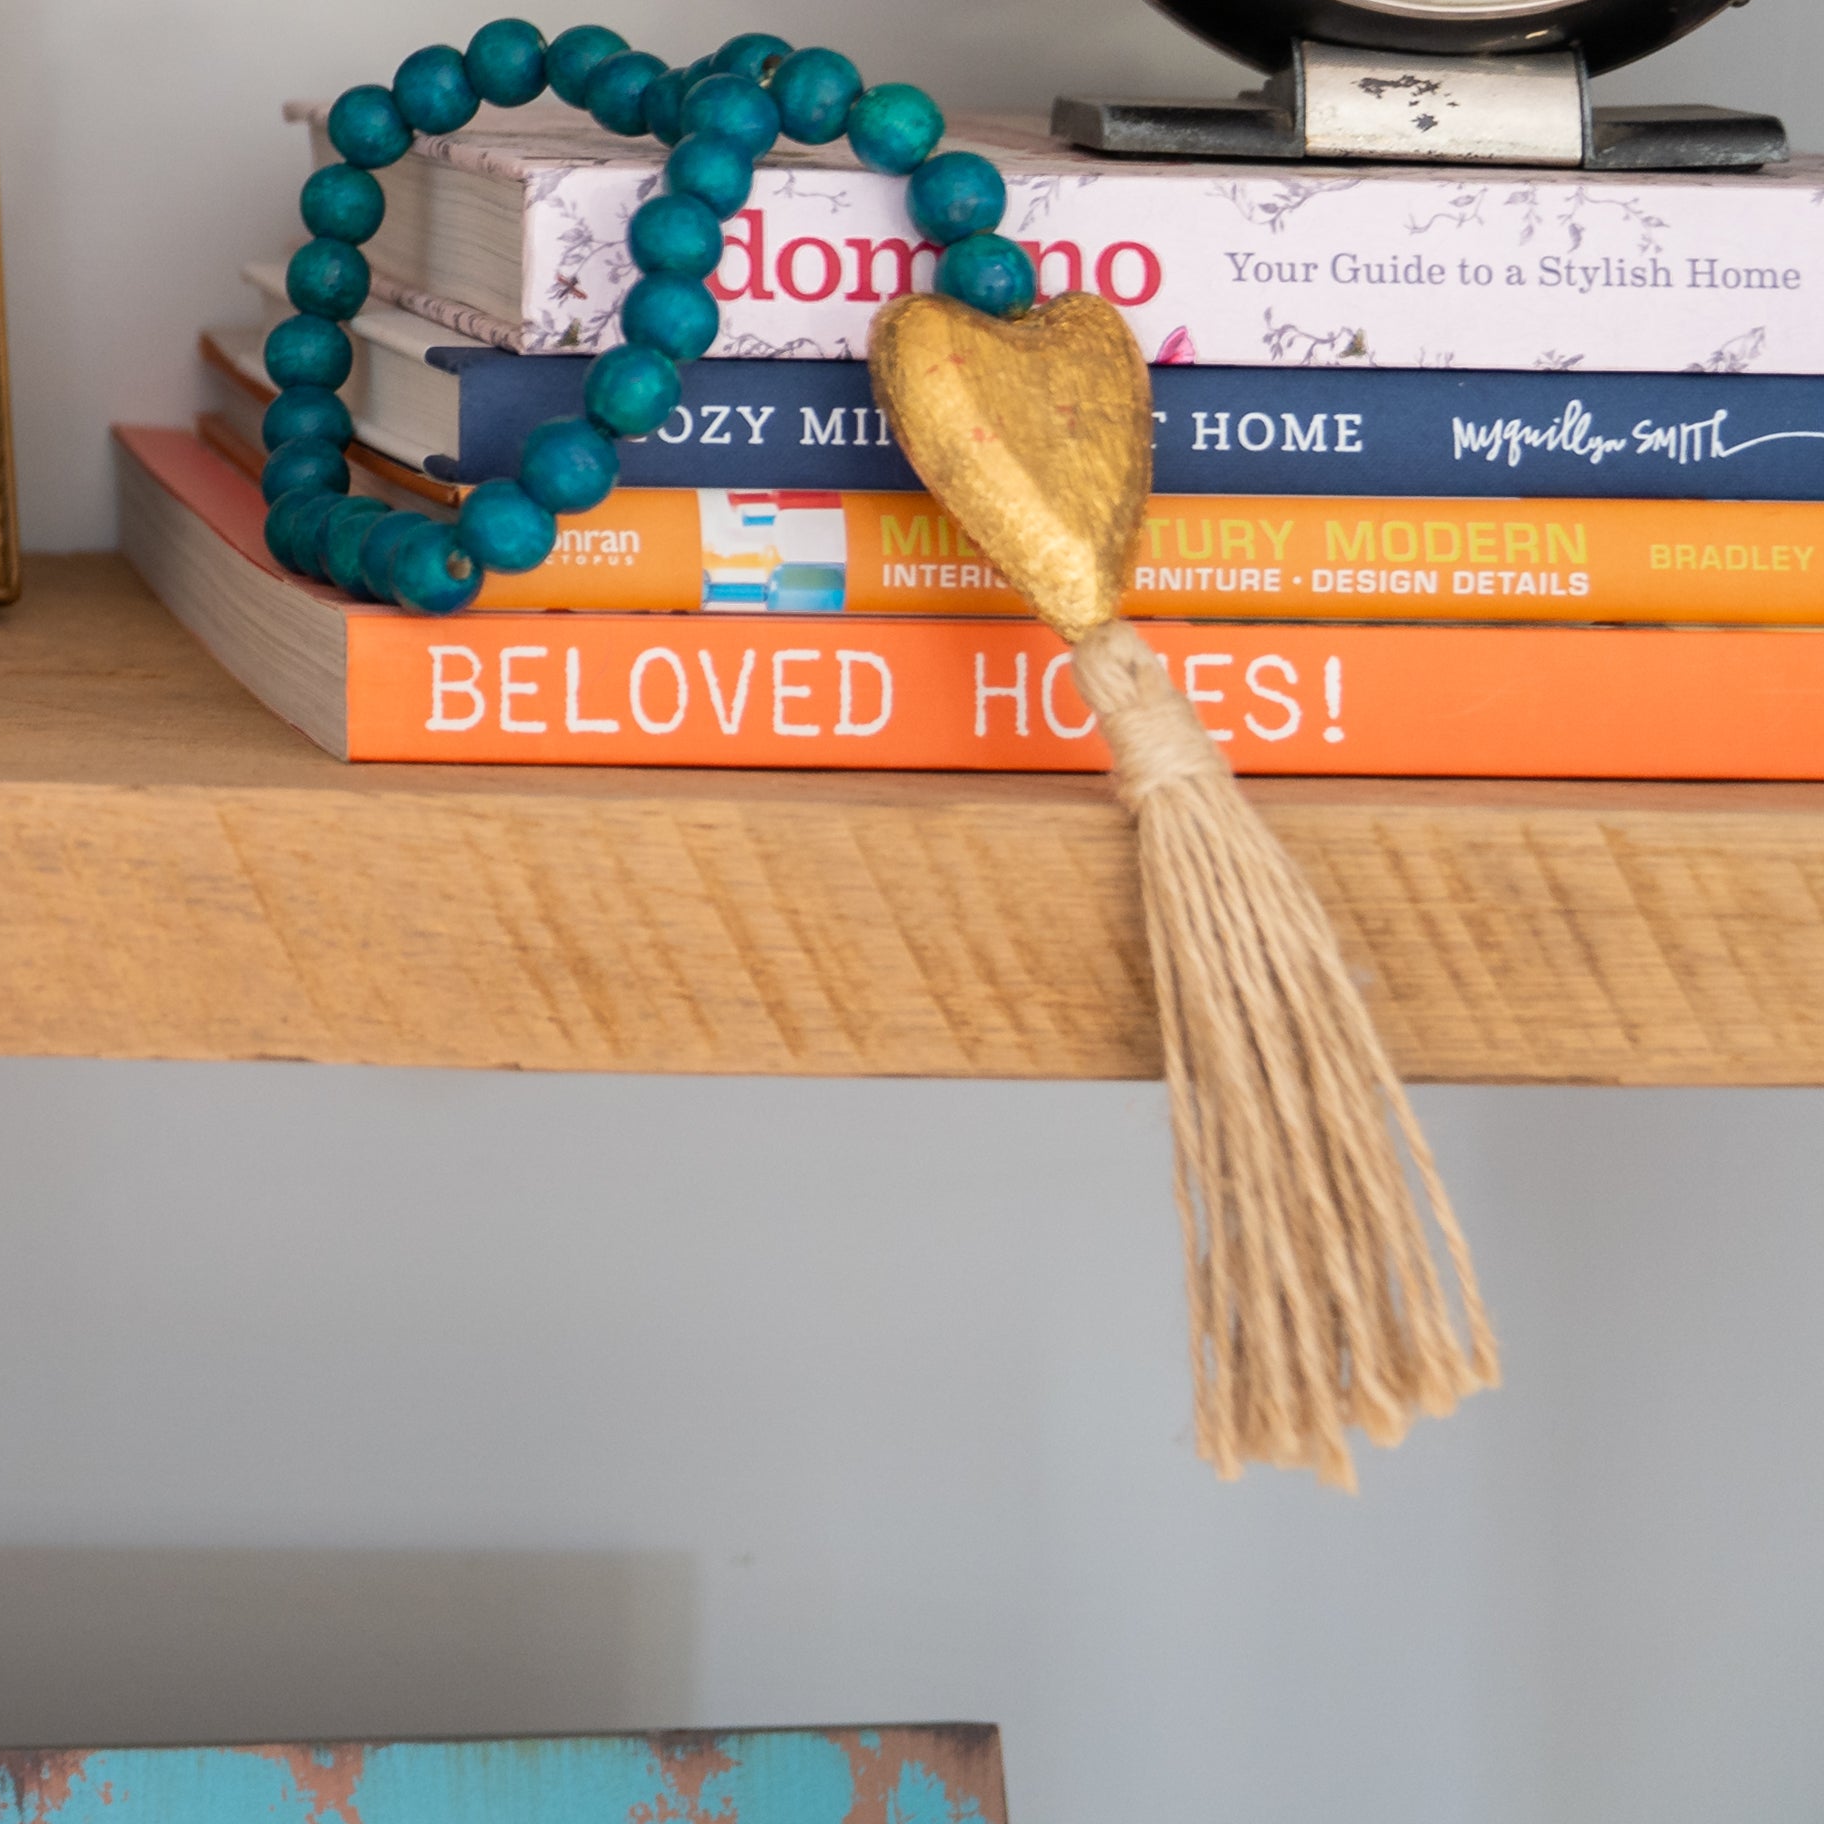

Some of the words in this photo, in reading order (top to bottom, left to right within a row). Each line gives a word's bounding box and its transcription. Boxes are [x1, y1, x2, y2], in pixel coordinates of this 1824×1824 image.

[704, 209, 1162, 307] domno
[1224, 252, 1319, 285] Your
[1330, 253, 1447, 287] Guide
[1458, 259, 1494, 287] to
[1505, 263, 1528, 288] a
[1538, 255, 1675, 294] Stylish
[1685, 257, 1803, 290] Home
[627, 404, 775, 445] OZY
[1191, 411, 1364, 452] HOME
[543, 555, 635, 567] CTOPUS
[1325, 520, 1588, 565] MODERN
[1650, 544, 1815, 571] BRADLEY
[1311, 569, 1437, 594] DESIGN
[1453, 570, 1589, 596] DETAILS
[425, 644, 893, 737] BELOVED
[973, 651, 1345, 743] HOES!
